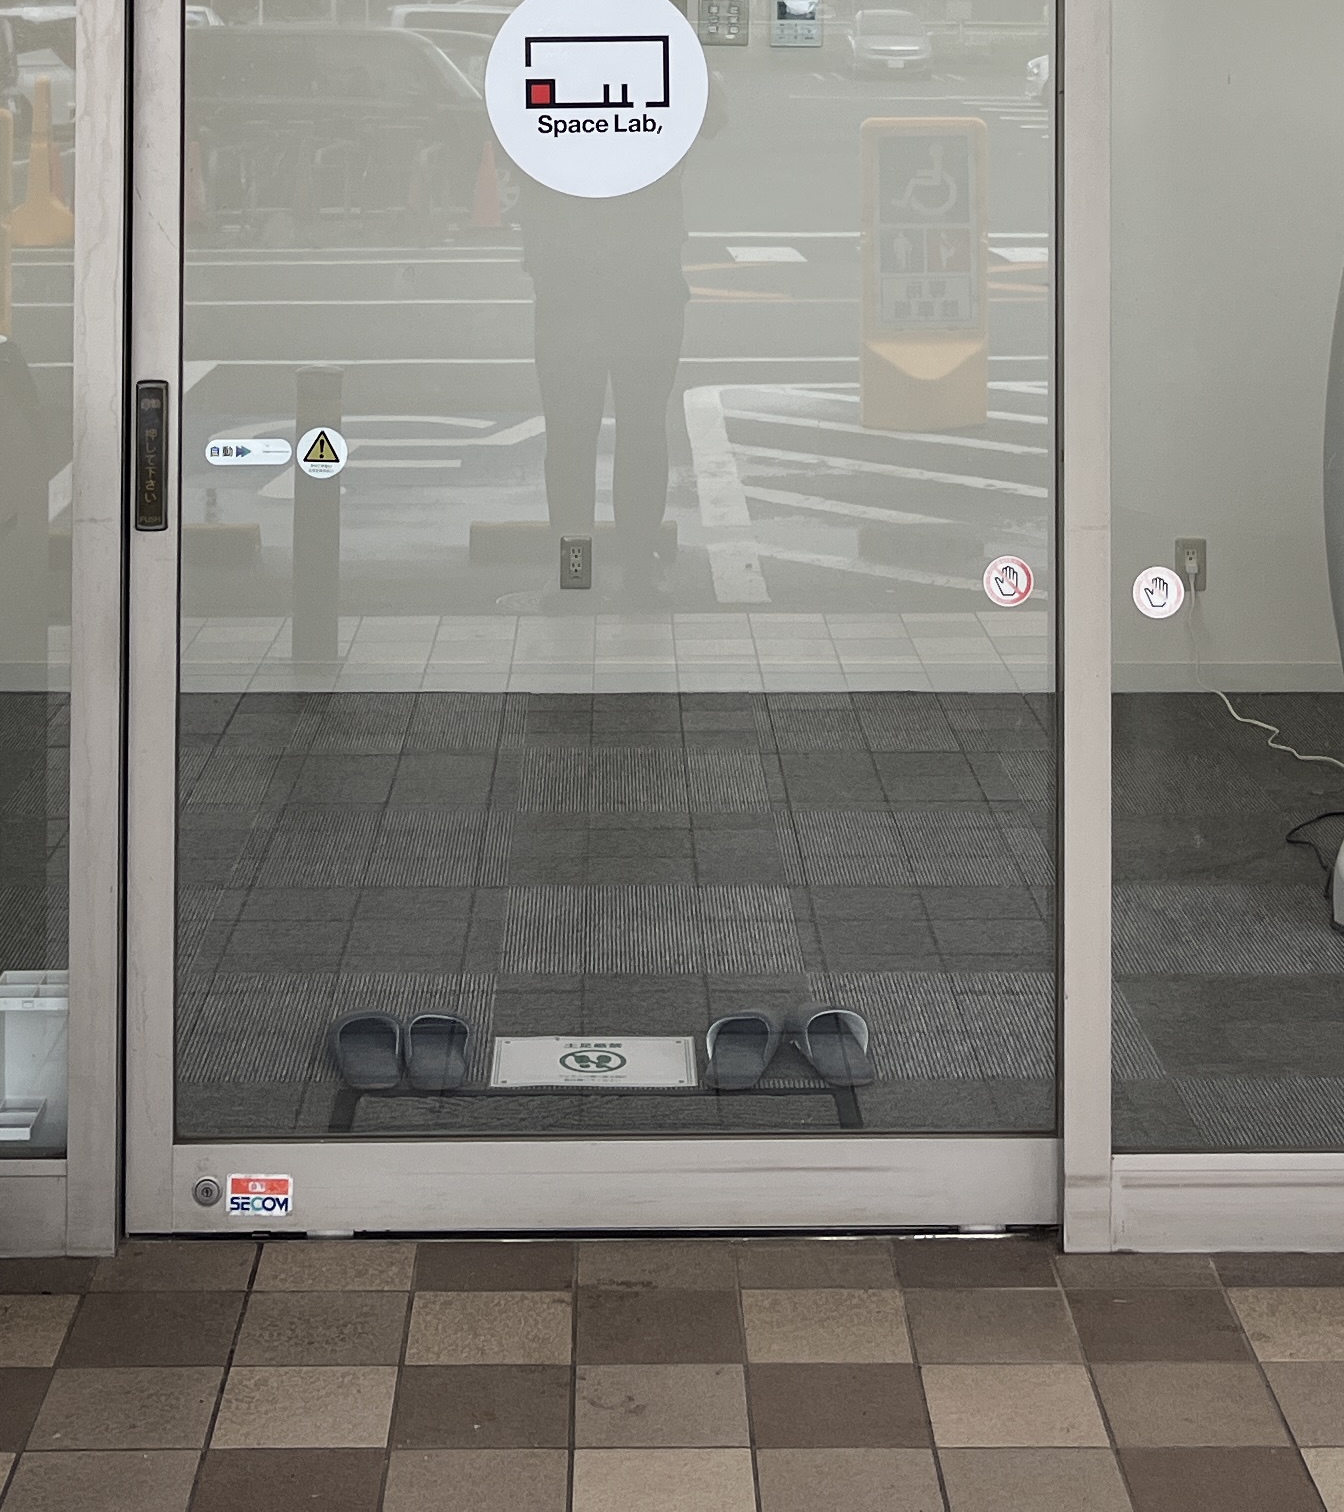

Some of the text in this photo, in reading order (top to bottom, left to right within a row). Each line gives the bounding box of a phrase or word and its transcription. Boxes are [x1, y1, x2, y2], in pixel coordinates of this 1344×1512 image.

[538, 114, 663, 137] Space Lab,
[144, 428, 158, 503] 押して下さい
[230, 1196, 288, 1212] SECOM
